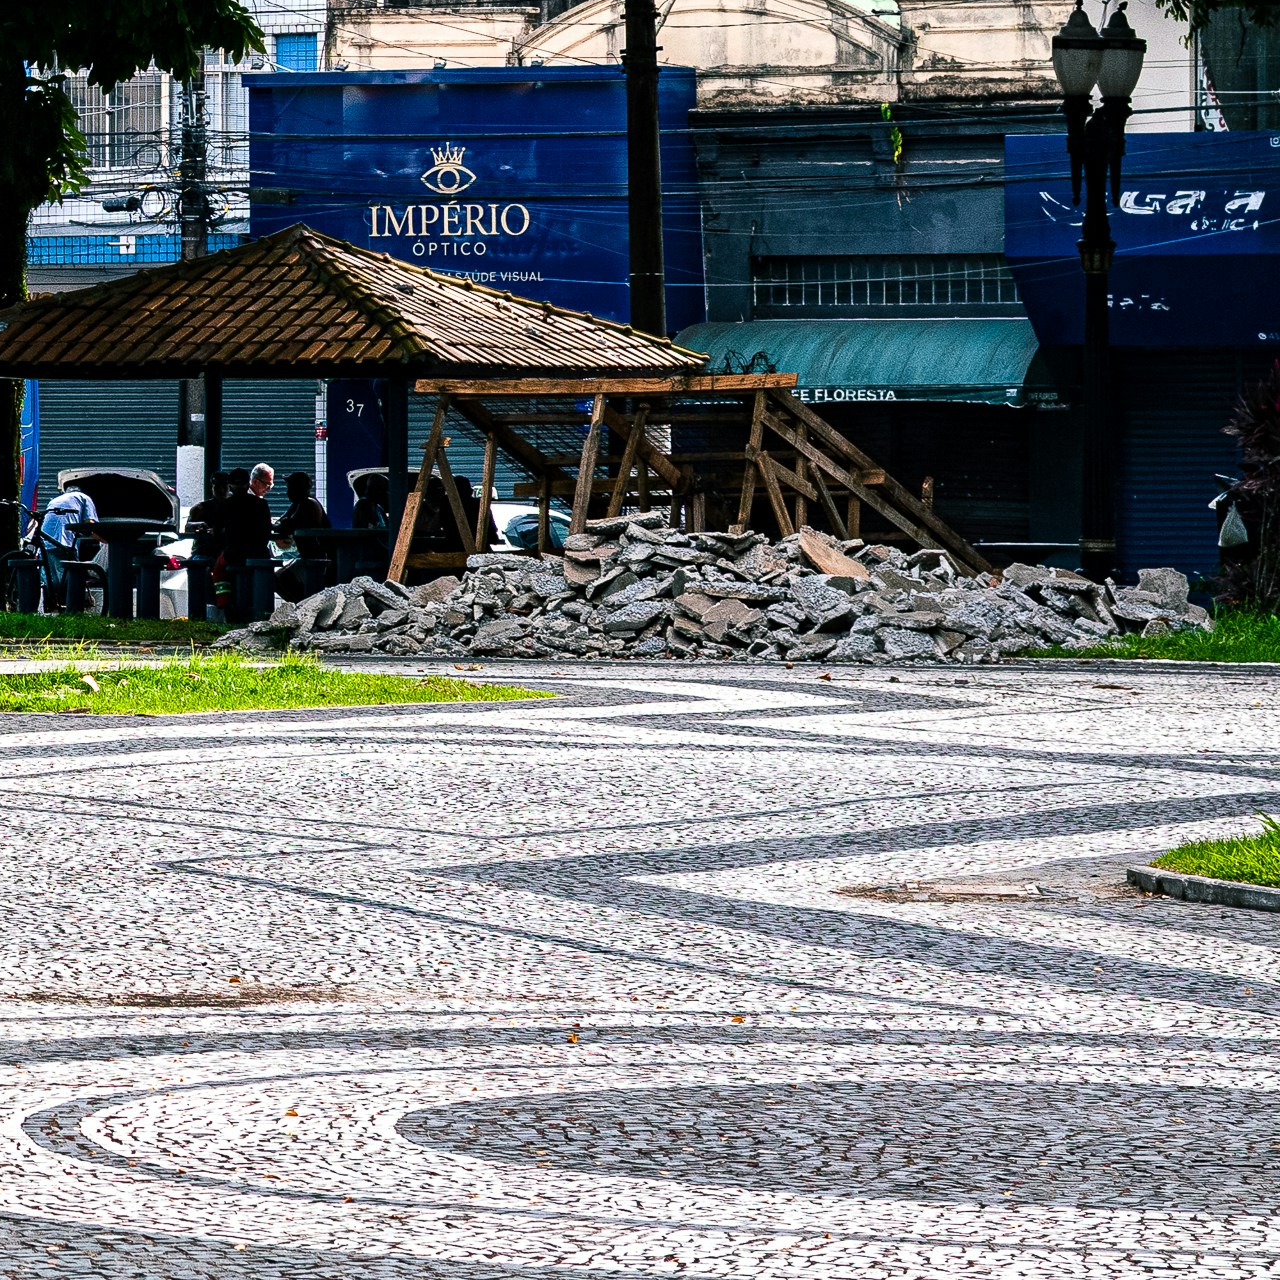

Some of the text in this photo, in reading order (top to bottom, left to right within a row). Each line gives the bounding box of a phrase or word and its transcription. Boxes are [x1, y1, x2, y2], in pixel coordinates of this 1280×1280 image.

[368, 200, 530, 237] IMPÉRIO
[412, 239, 487, 256] ÓPTICO
[500, 271, 544, 282] VISUAL
[815, 388, 897, 401] FLORESTA
[346, 398, 364, 417] 37
